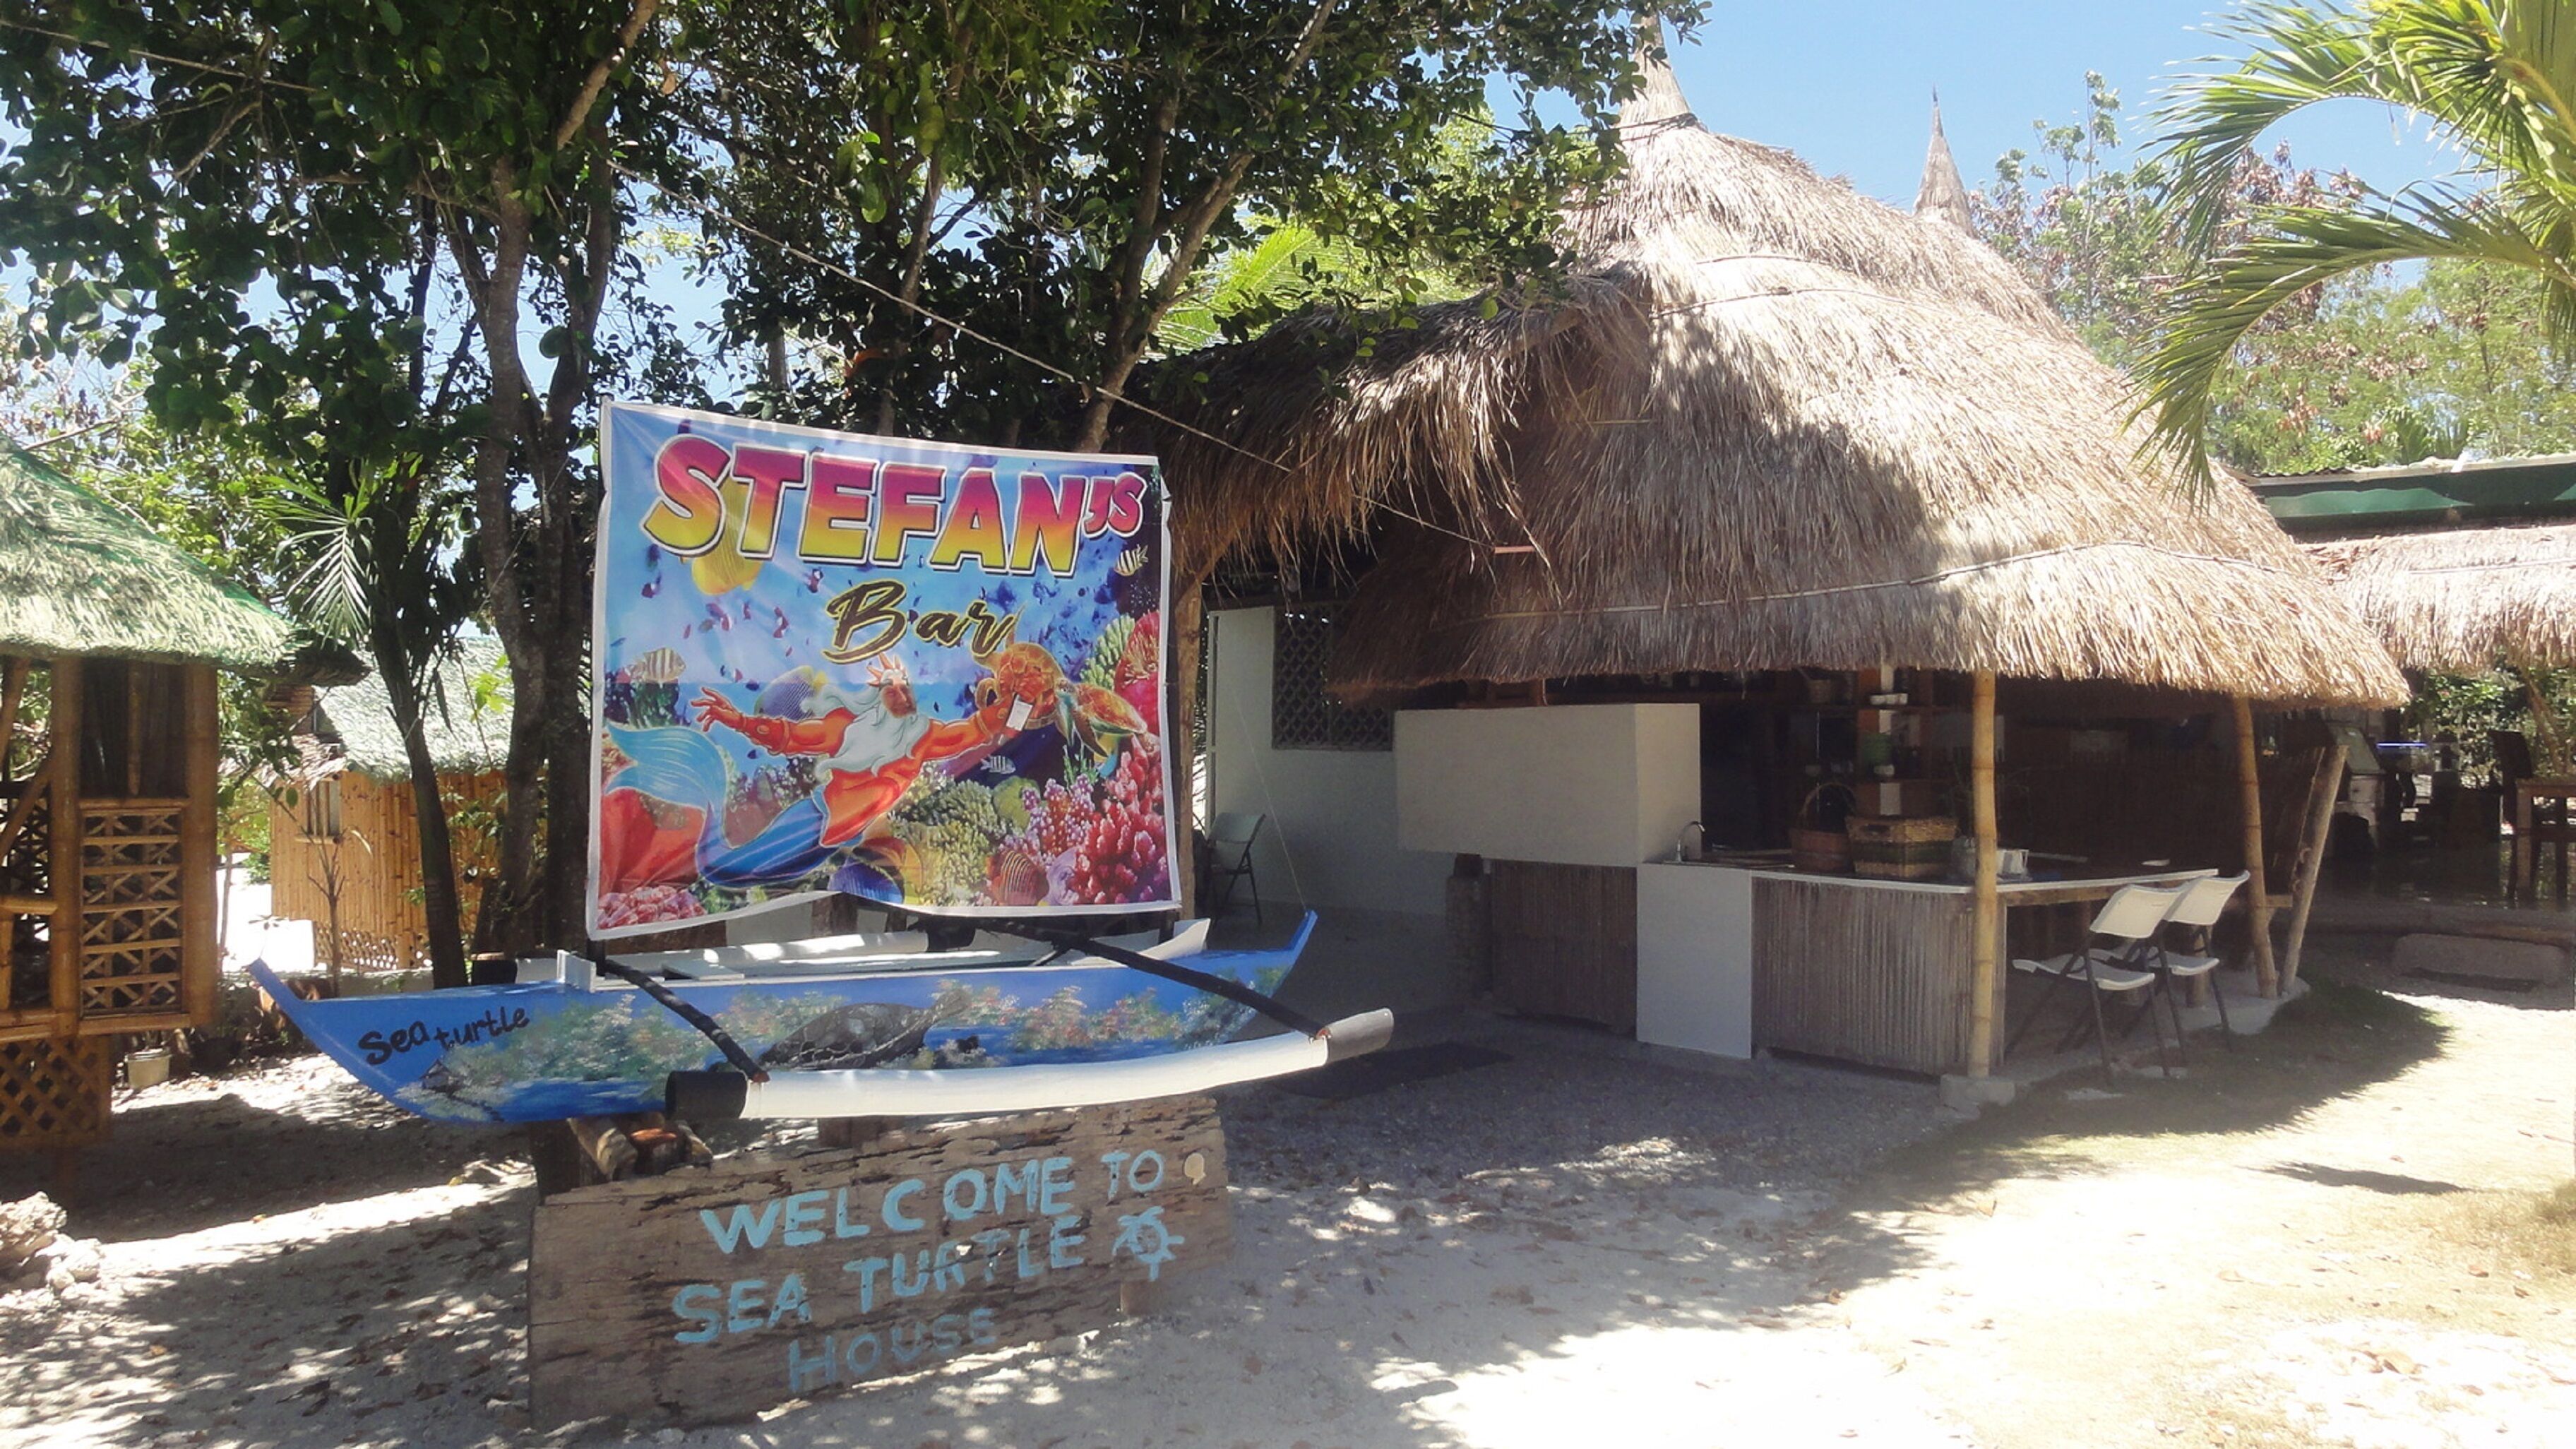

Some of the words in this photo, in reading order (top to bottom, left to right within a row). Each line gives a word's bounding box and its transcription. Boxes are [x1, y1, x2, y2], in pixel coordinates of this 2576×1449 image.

[641, 435, 1147, 578] STEFAN'S
[823, 580, 1020, 662] Bar
[358, 1020, 429, 1066] Sea
[434, 1006, 530, 1049] turtle
[702, 1156, 1075, 1254] WELCOME
[1101, 1150, 1164, 1200] TO
[673, 1273, 811, 1343] SEA
[844, 1216, 1085, 1313] TURTLE
[787, 1308, 997, 1393] HOUSE
